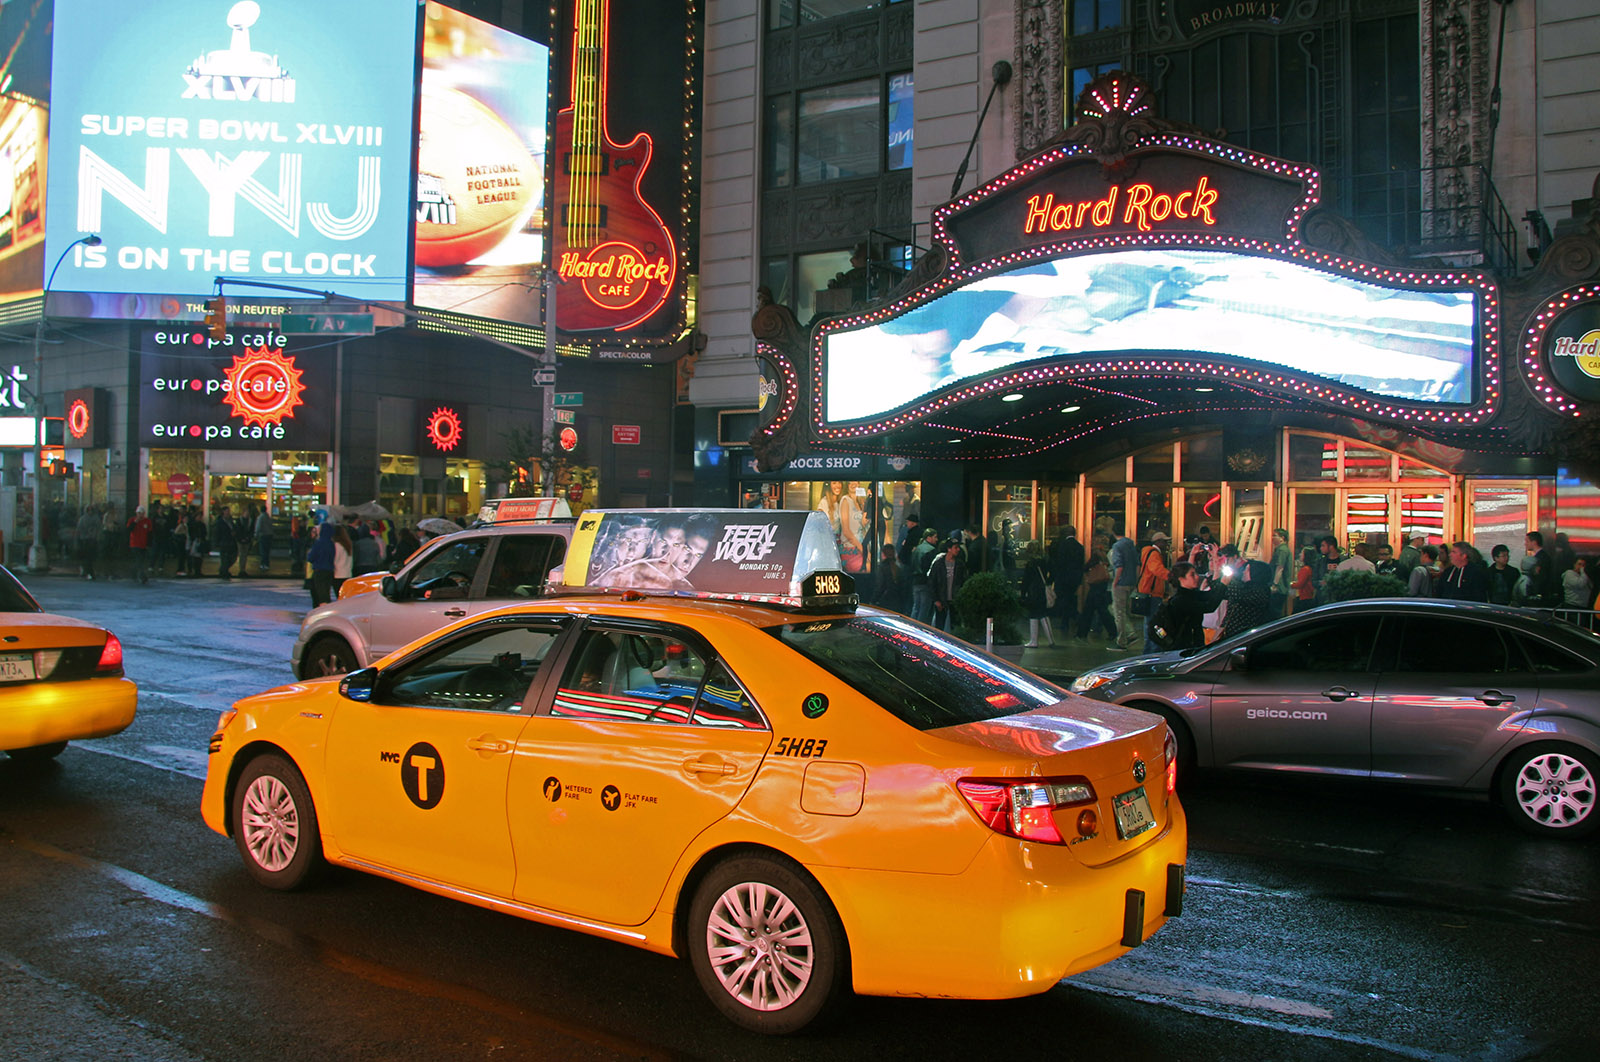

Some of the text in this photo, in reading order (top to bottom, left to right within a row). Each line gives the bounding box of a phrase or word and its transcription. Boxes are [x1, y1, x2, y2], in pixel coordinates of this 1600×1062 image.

[1190, 2, 1281, 31] BROADWAY
[181, 73, 296, 103] XLVIII
[81, 114, 383, 147] SUPER BOWL XLVIII
[466, 163, 520, 177] NATIONAL
[467, 177, 520, 192] FOOTBALL
[476, 191, 516, 205] LEAGUE
[1024, 176, 1218, 234] Hard Rock
[73, 244, 377, 277] IS ON THE CLOCK
[560, 252, 670, 286] Hard Rock
[598, 284, 631, 296] CAFE
[308, 317, 317, 330] 7
[1554, 336, 1598, 356] Hard
[599, 351, 652, 359] SPECTACOLOR
[153, 376, 287, 395] europa café
[560, 394, 567, 405] 7
[152, 422, 286, 441] europa café
[788, 457, 861, 469] ROCK SHOP
[720, 522, 778, 543] TEEN
[711, 540, 777, 564] WOLF
[739, 563, 769, 571] MONDAYS
[815, 574, 841, 595] 5H83
[1246, 706, 1328, 720] geico.com
[774, 737, 828, 758] 5H83
[380, 751, 436, 801] NYC T
[564, 791, 580, 800] FARE
[565, 784, 593, 795] METERED
[624, 792, 658, 804] FLAT FARE
[624, 801, 637, 809] JFK
